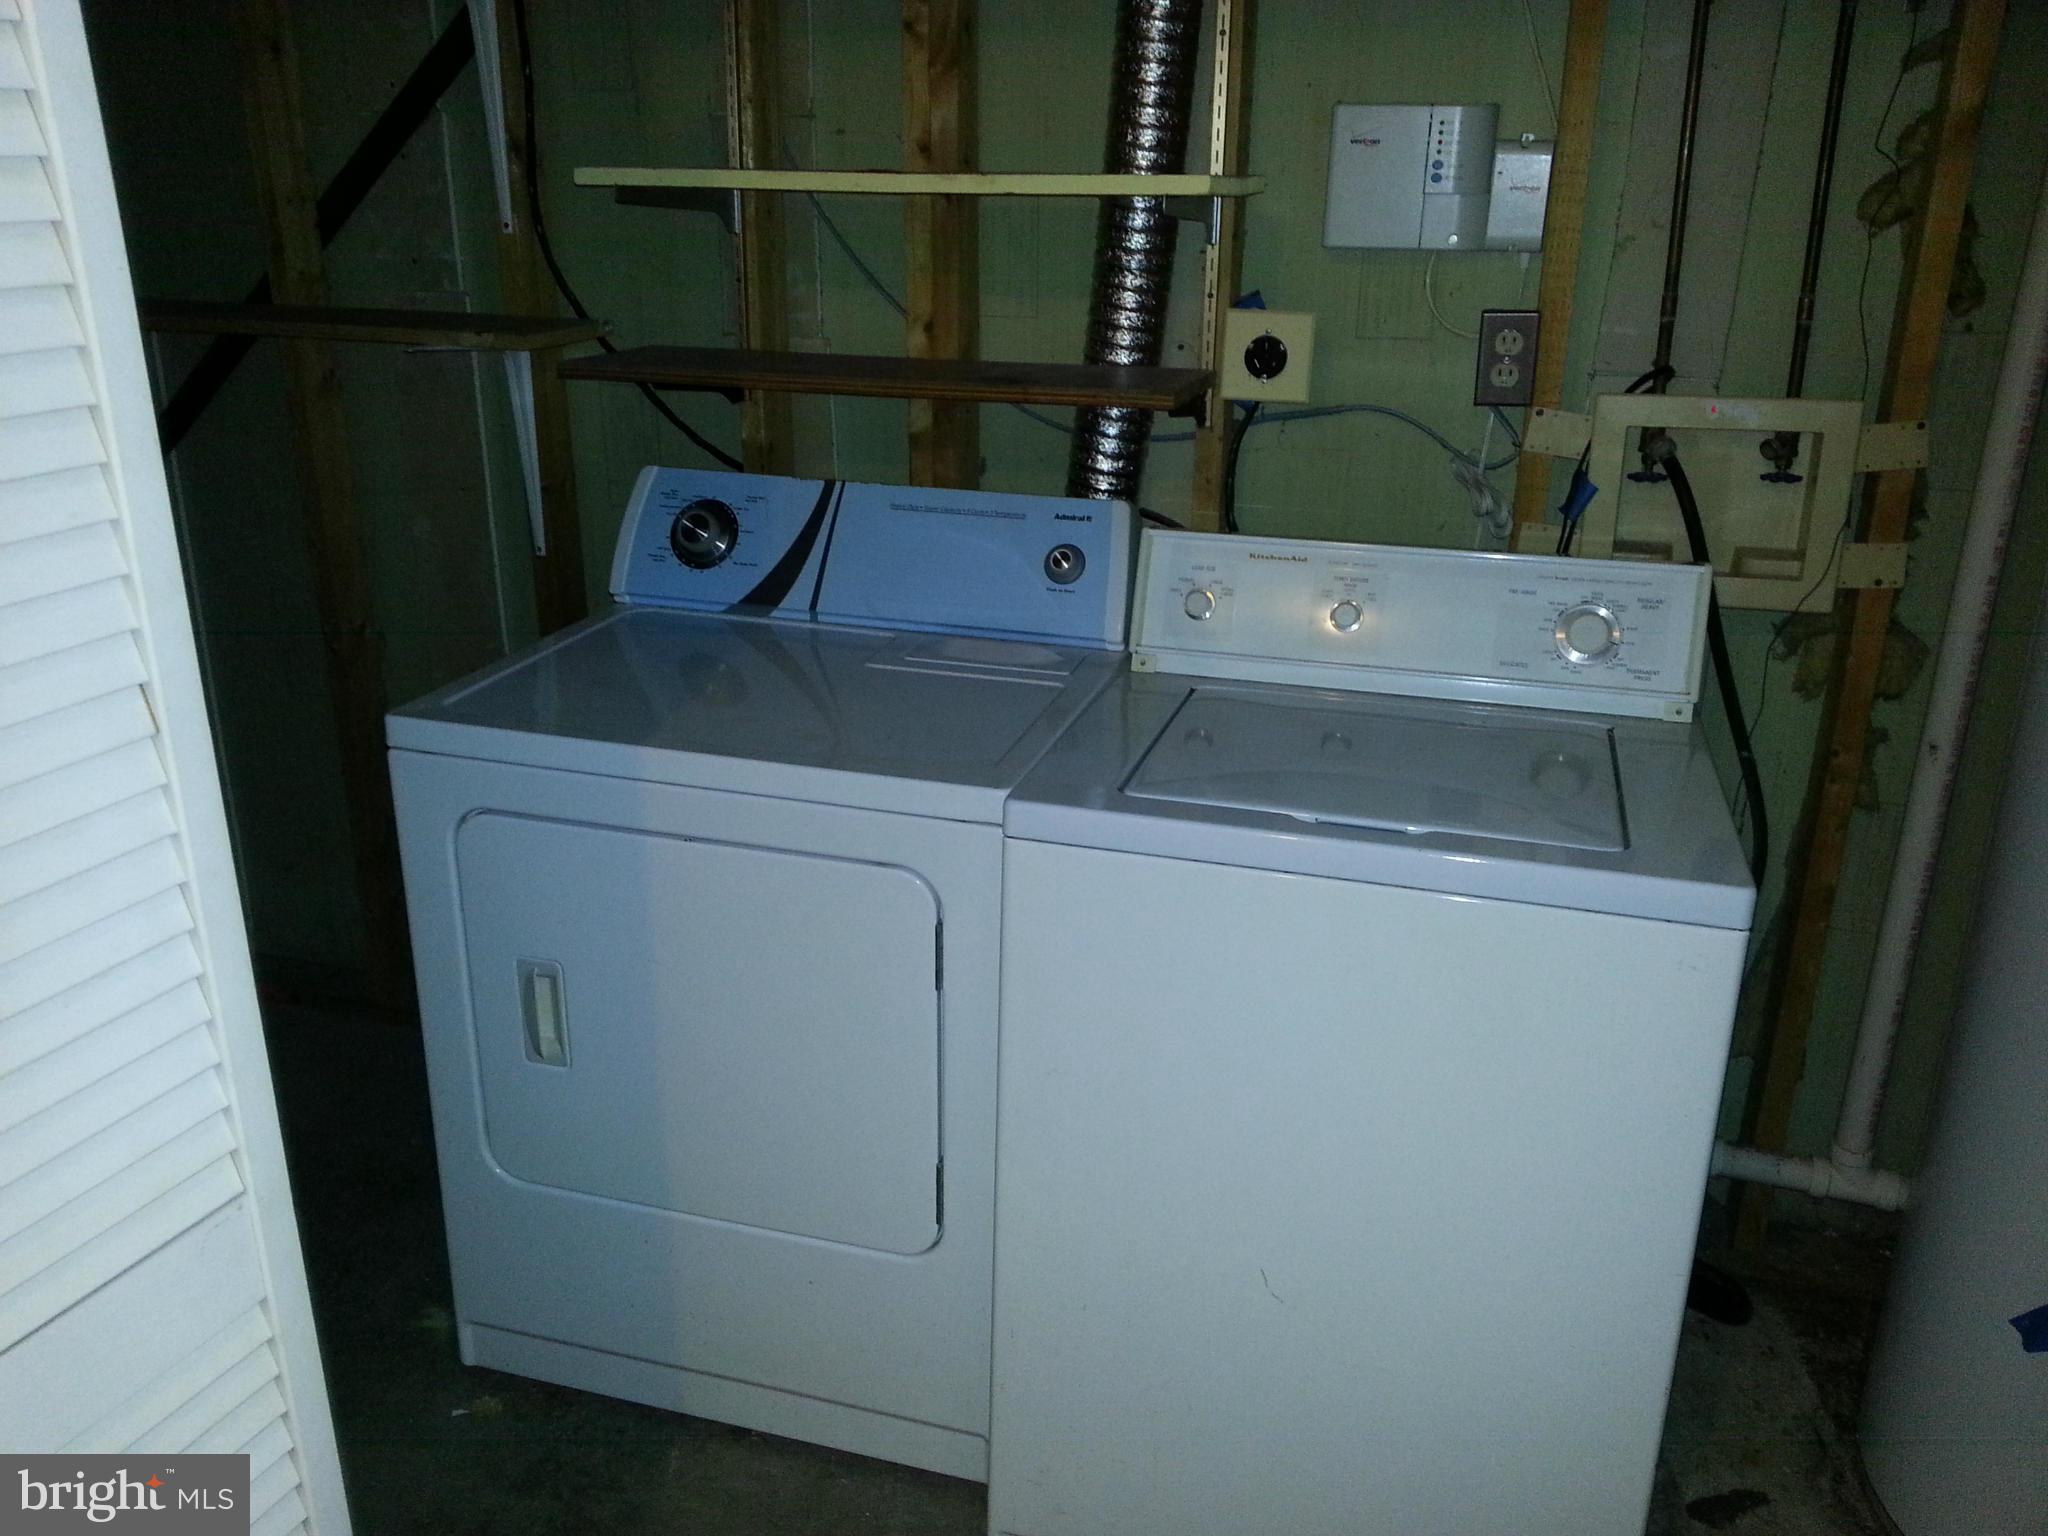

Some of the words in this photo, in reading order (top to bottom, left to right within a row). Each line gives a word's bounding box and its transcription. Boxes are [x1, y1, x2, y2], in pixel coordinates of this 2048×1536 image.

[1350, 137, 1381, 147] verizon
[1509, 184, 1541, 194] verizon
[1054, 513, 1085, 522] Admiral
[1249, 552, 1309, 563] KitchenAid
